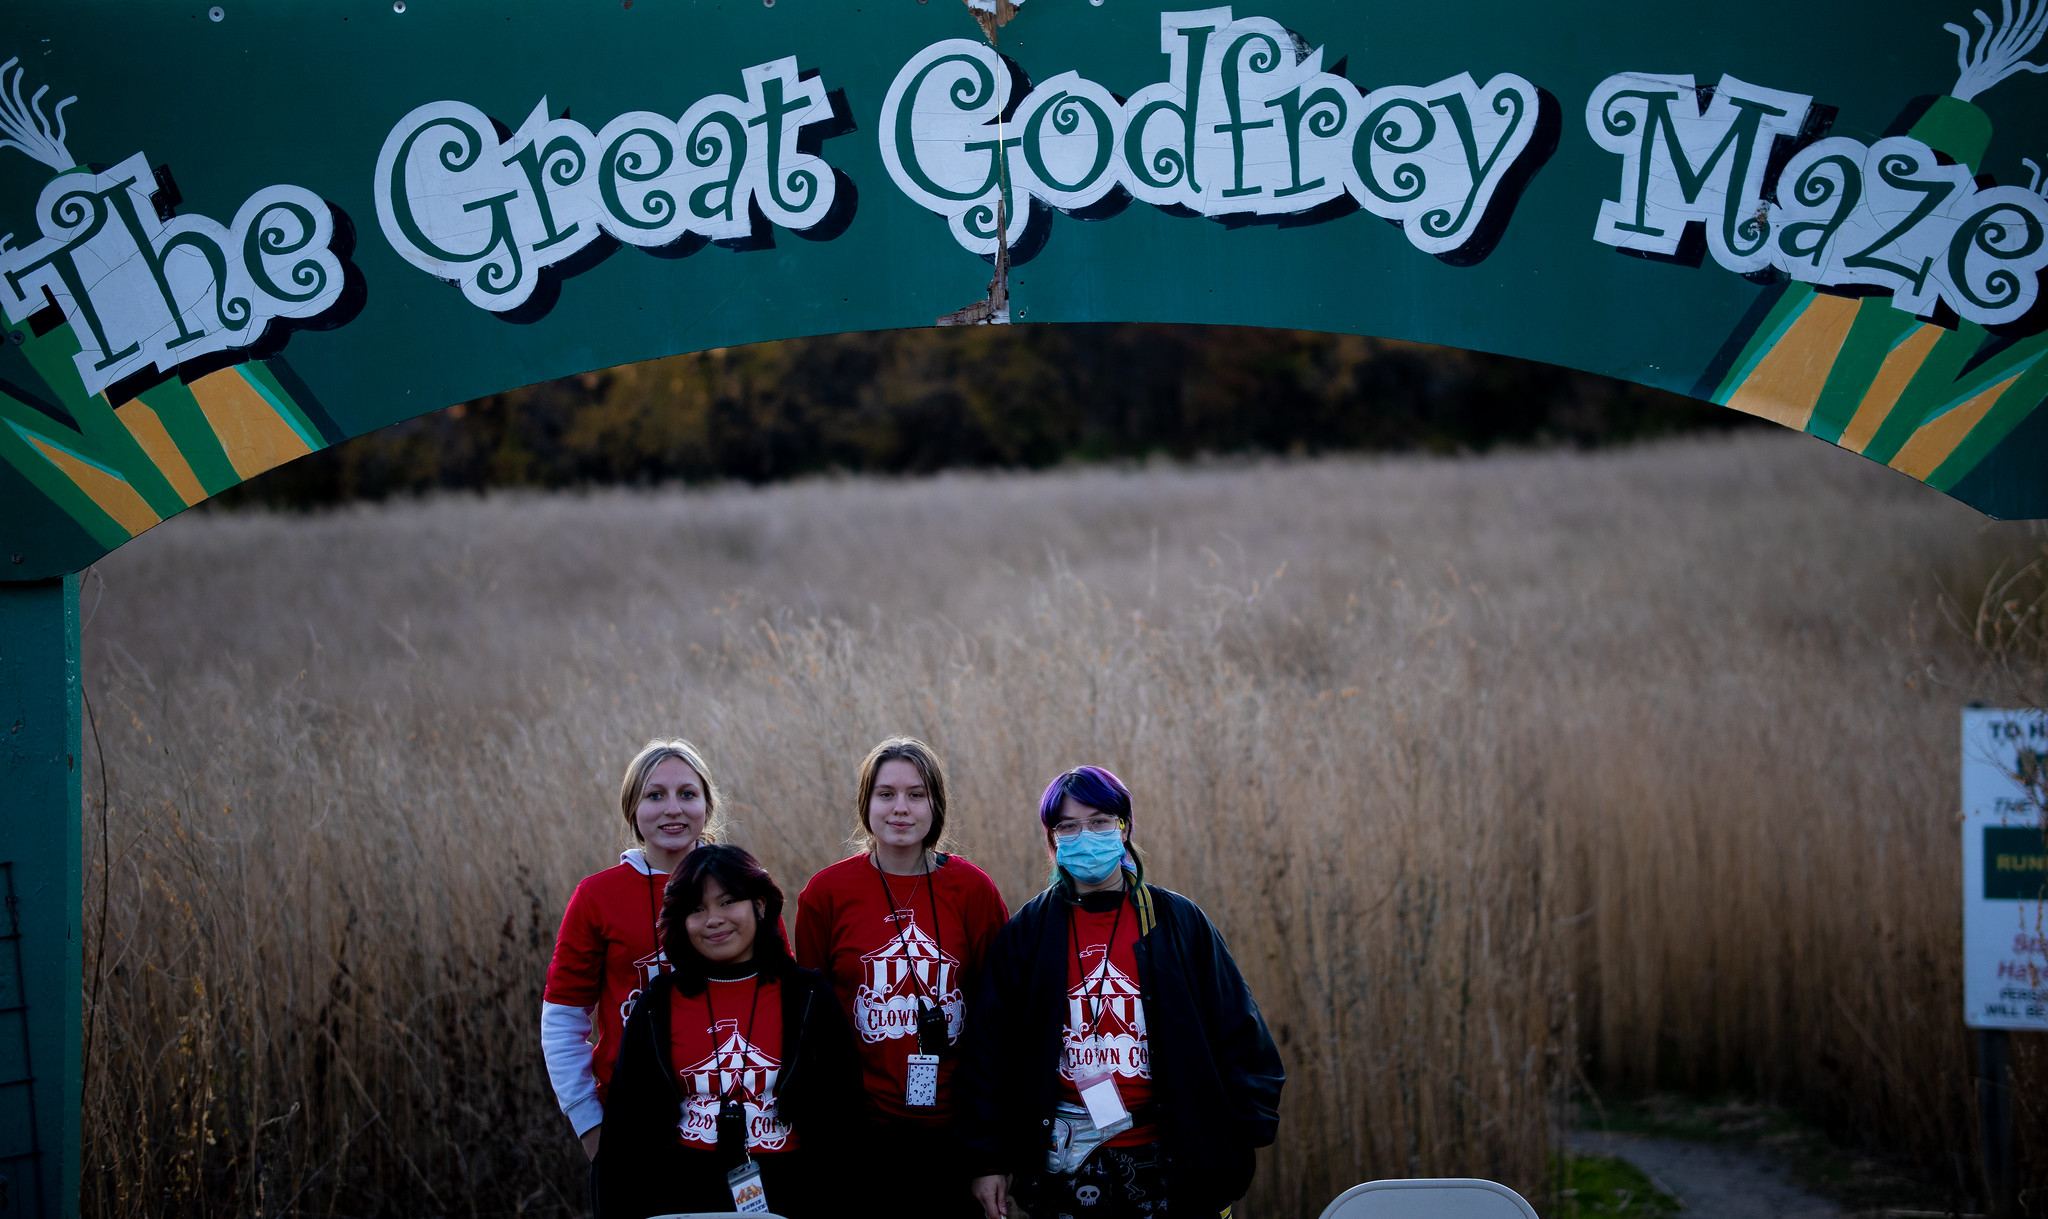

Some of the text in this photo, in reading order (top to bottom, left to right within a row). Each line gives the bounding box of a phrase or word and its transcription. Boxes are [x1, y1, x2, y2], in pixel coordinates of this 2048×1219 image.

[4, 26, 2044, 371] The Great Godfrey Maze
[1066, 1046, 1149, 1068] CLOWN CO
